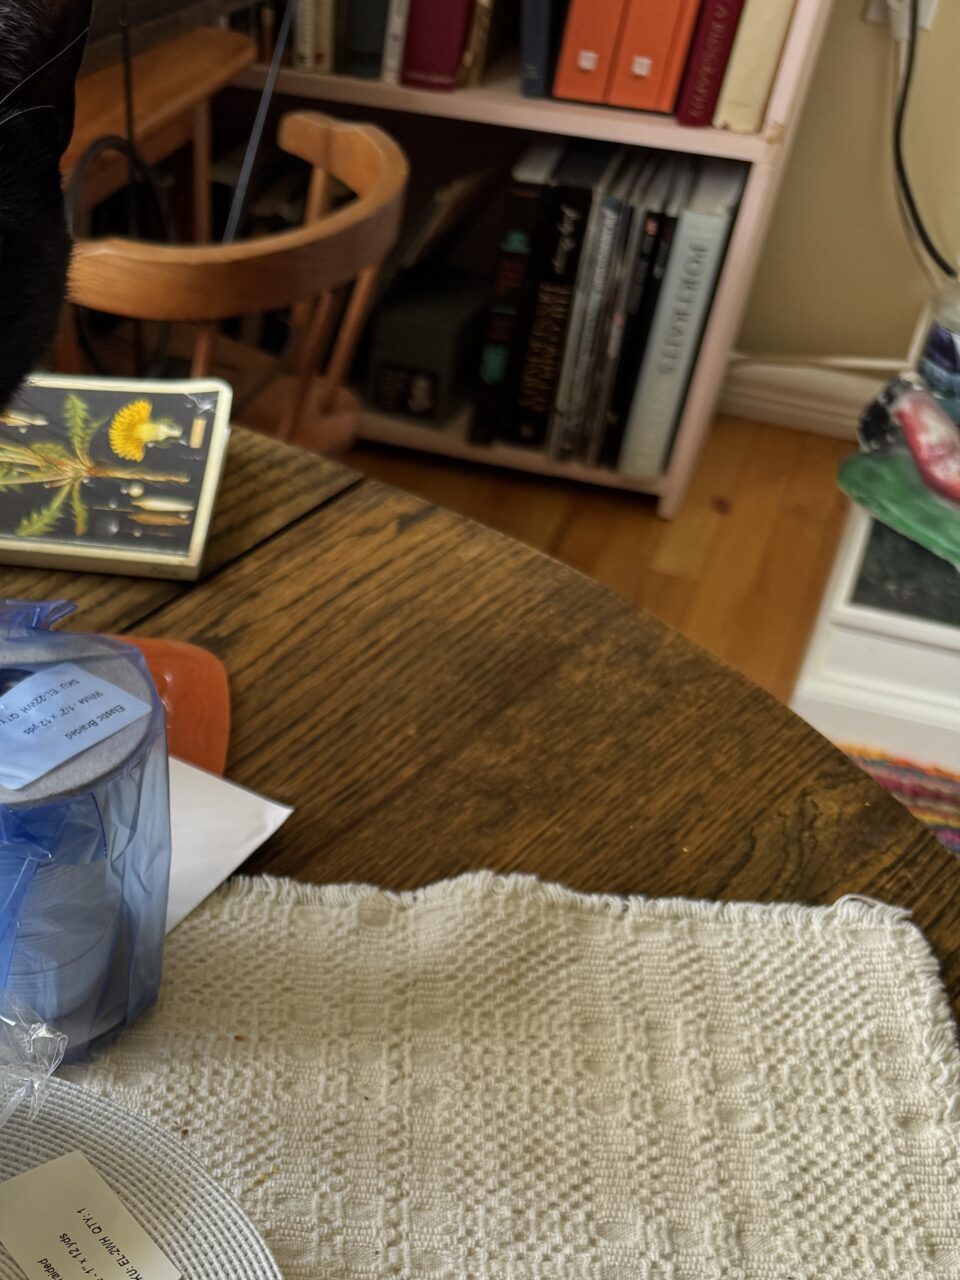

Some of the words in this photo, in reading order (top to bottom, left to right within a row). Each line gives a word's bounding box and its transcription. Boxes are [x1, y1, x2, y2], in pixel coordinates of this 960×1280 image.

[96, 704, 126, 722] Elastic
[39, 719, 52, 728] 12
[65, 720, 100, 740] Braided
[82, 1213, 102, 1235] QTY:
[59, 1232, 77, 1249] yds
[68, 1247, 80, 1259] 12
[99, 1236, 130, 1267] EL-2WH
[79, 1257, 88, 1265] x
[81, 1265, 95, 1274] 1"
